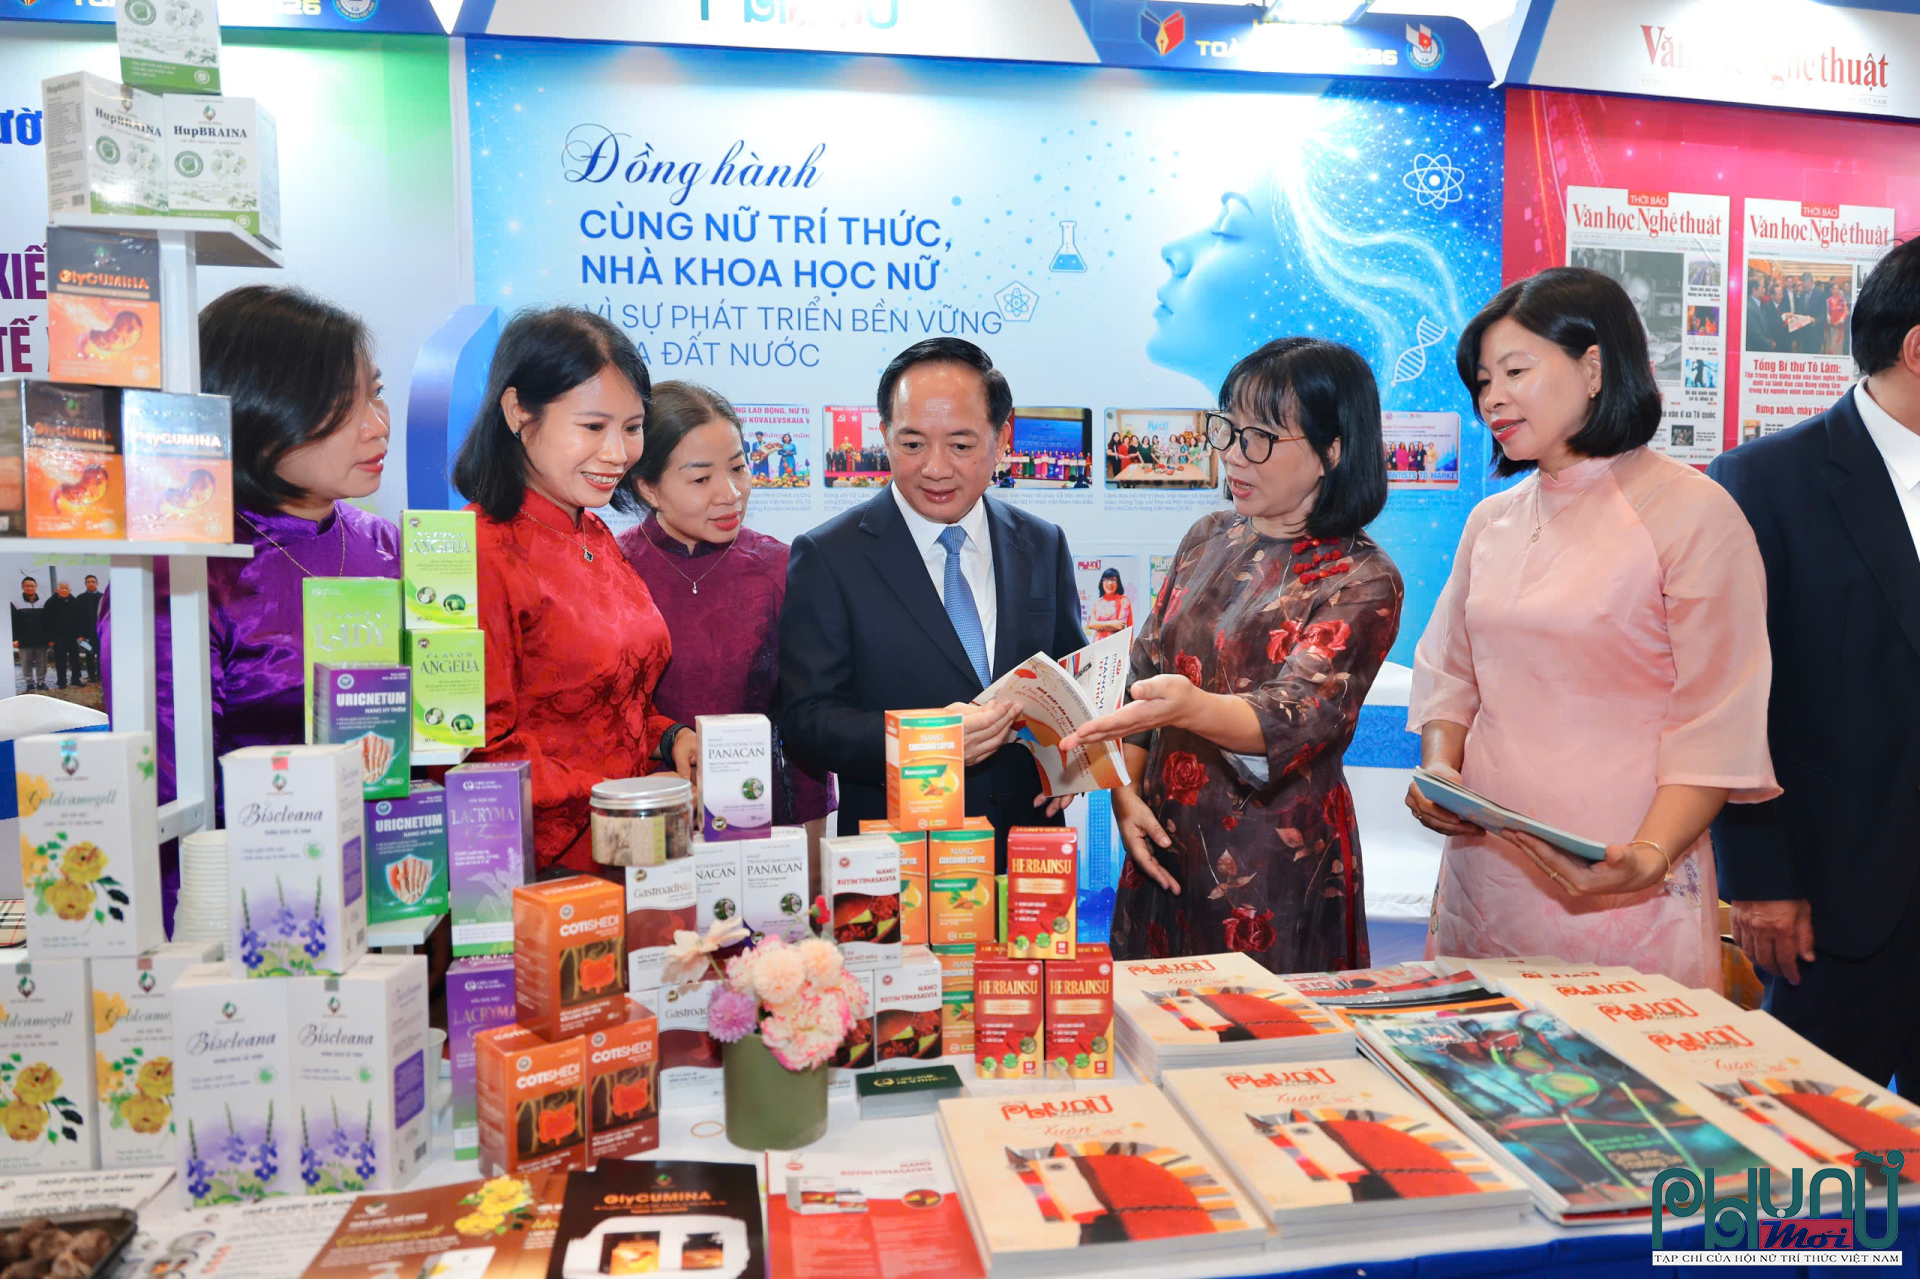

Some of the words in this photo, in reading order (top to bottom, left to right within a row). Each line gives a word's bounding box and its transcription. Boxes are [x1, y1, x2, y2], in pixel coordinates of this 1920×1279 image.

[1820, 46, 1889, 90] thuật
[174, 125, 248, 139] HupBRAINA
[561, 123, 710, 206] Đồng
[710, 139, 826, 189] hành
[1630, 194, 1649, 204] THỜI
[1650, 194, 1668, 206] BÁO
[1803, 206, 1821, 216] THỜI
[1822, 207, 1838, 217] BÁO
[580, 201, 693, 241] CÙNG
[705, 205, 760, 243] NỮ
[768, 207, 828, 244] TRÍ
[837, 209, 951, 252] THỨC,
[1573, 203, 1604, 228] Văn
[1607, 205, 1635, 232] học
[1638, 207, 1678, 238] Nghệ
[1680, 210, 1722, 237] thuật
[1750, 214, 1778, 238] Văn
[1781, 217, 1808, 243] học
[1810, 219, 1848, 248] Nghệ
[1850, 222, 1891, 247] thuật
[582, 246, 663, 286] NHÀ
[674, 256, 783, 287] KHOA
[794, 259, 876, 297] HỌC
[887, 254, 940, 291] NỮ
[622, 302, 664, 335] SỰ
[671, 299, 748, 330] PHÁT
[757, 296, 842, 331] TRIỂN
[852, 298, 908, 332] BỀN
[917, 304, 1002, 335] VỮNG
[661, 331, 721, 365] ĐẤT
[731, 336, 820, 367] NƯỚC
[749, 416, 804, 424] KOVALEVSKAIA
[1419, 471, 1428, 479] TO
[336, 691, 406, 707] URICNETUM
[708, 747, 765, 760] PANACAN
[238, 802, 323, 828] Biscleana
[375, 813, 443, 833] URICNETUM
[747, 863, 803, 875] PANACAN
[1011, 858, 1072, 874] HERBAINSU
[559, 914, 619, 937] COTISHEDI
[978, 979, 1038, 995] HERBAINSU
[1050, 979, 1110, 995] HERBAINSU
[186, 1031, 277, 1056] Biscleana
[298, 1023, 375, 1047] Biscleana
[591, 1040, 652, 1064] COTISHEDI
[516, 1063, 580, 1090] COTISHEDI
[603, 1190, 712, 1205] GlyCUMINA
